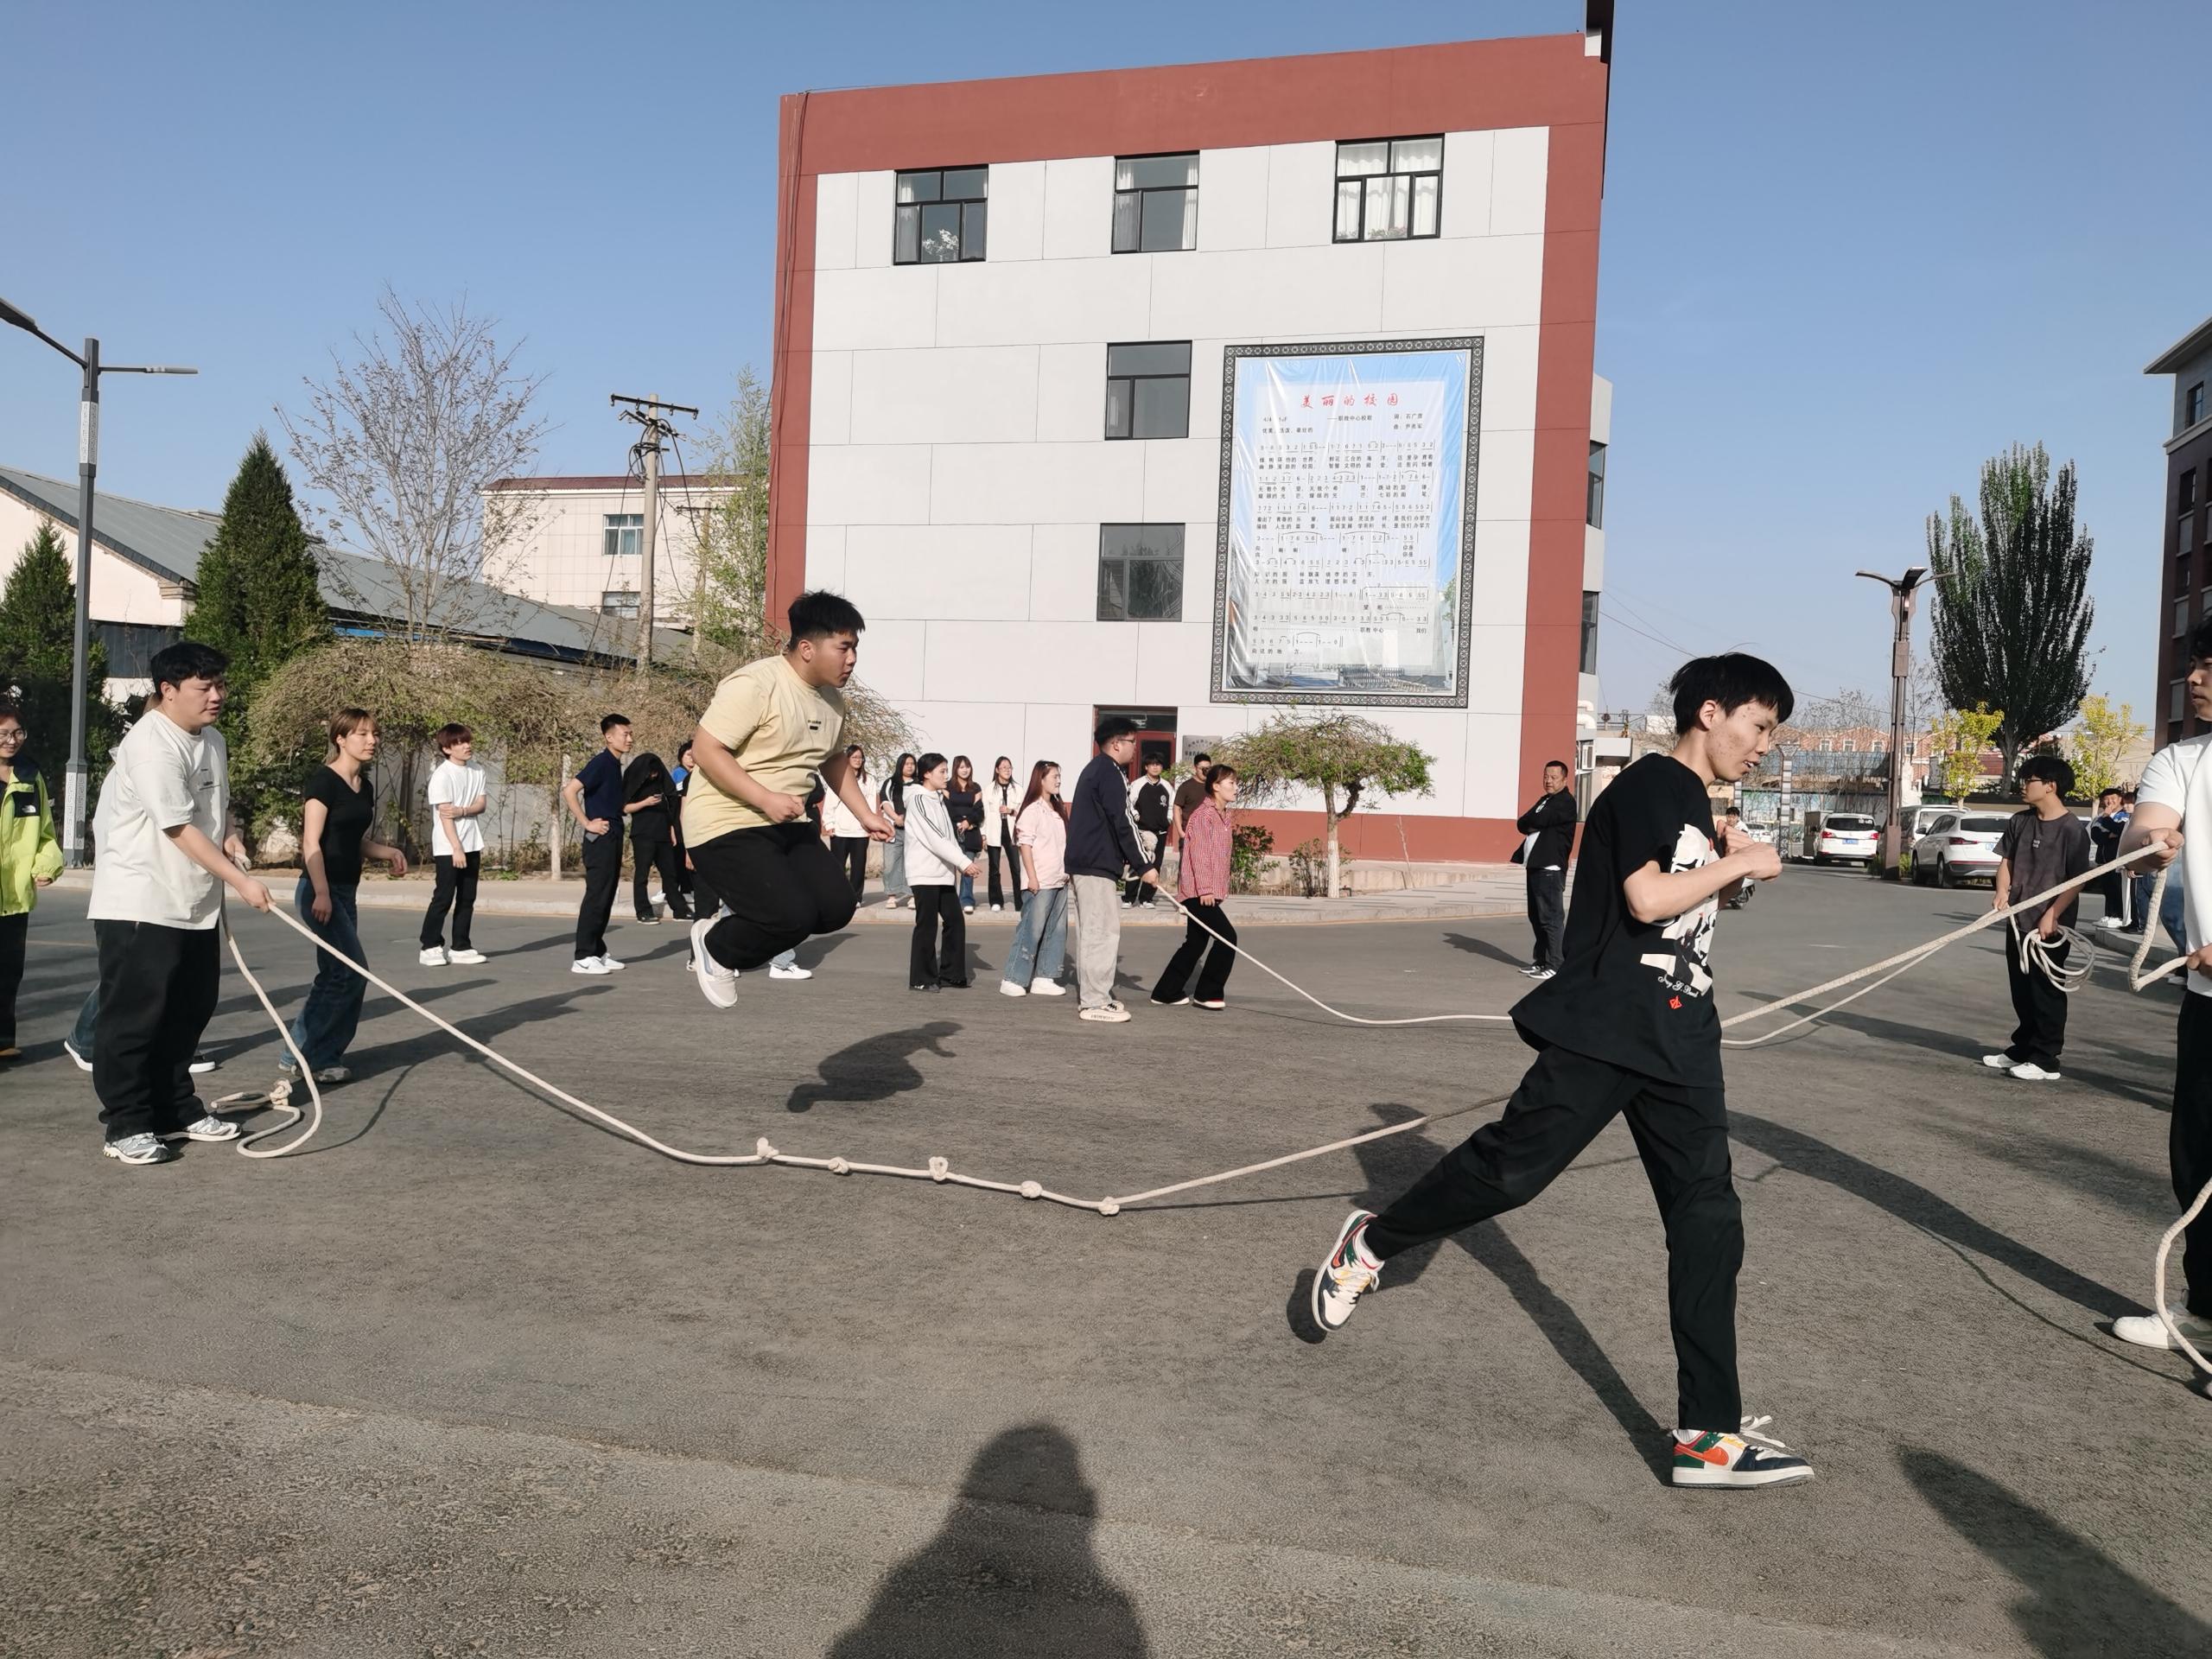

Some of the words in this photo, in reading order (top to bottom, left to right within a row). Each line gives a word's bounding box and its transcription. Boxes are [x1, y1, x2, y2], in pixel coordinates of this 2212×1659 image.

[1300, 393, 1399, 409] 美丽的校园
